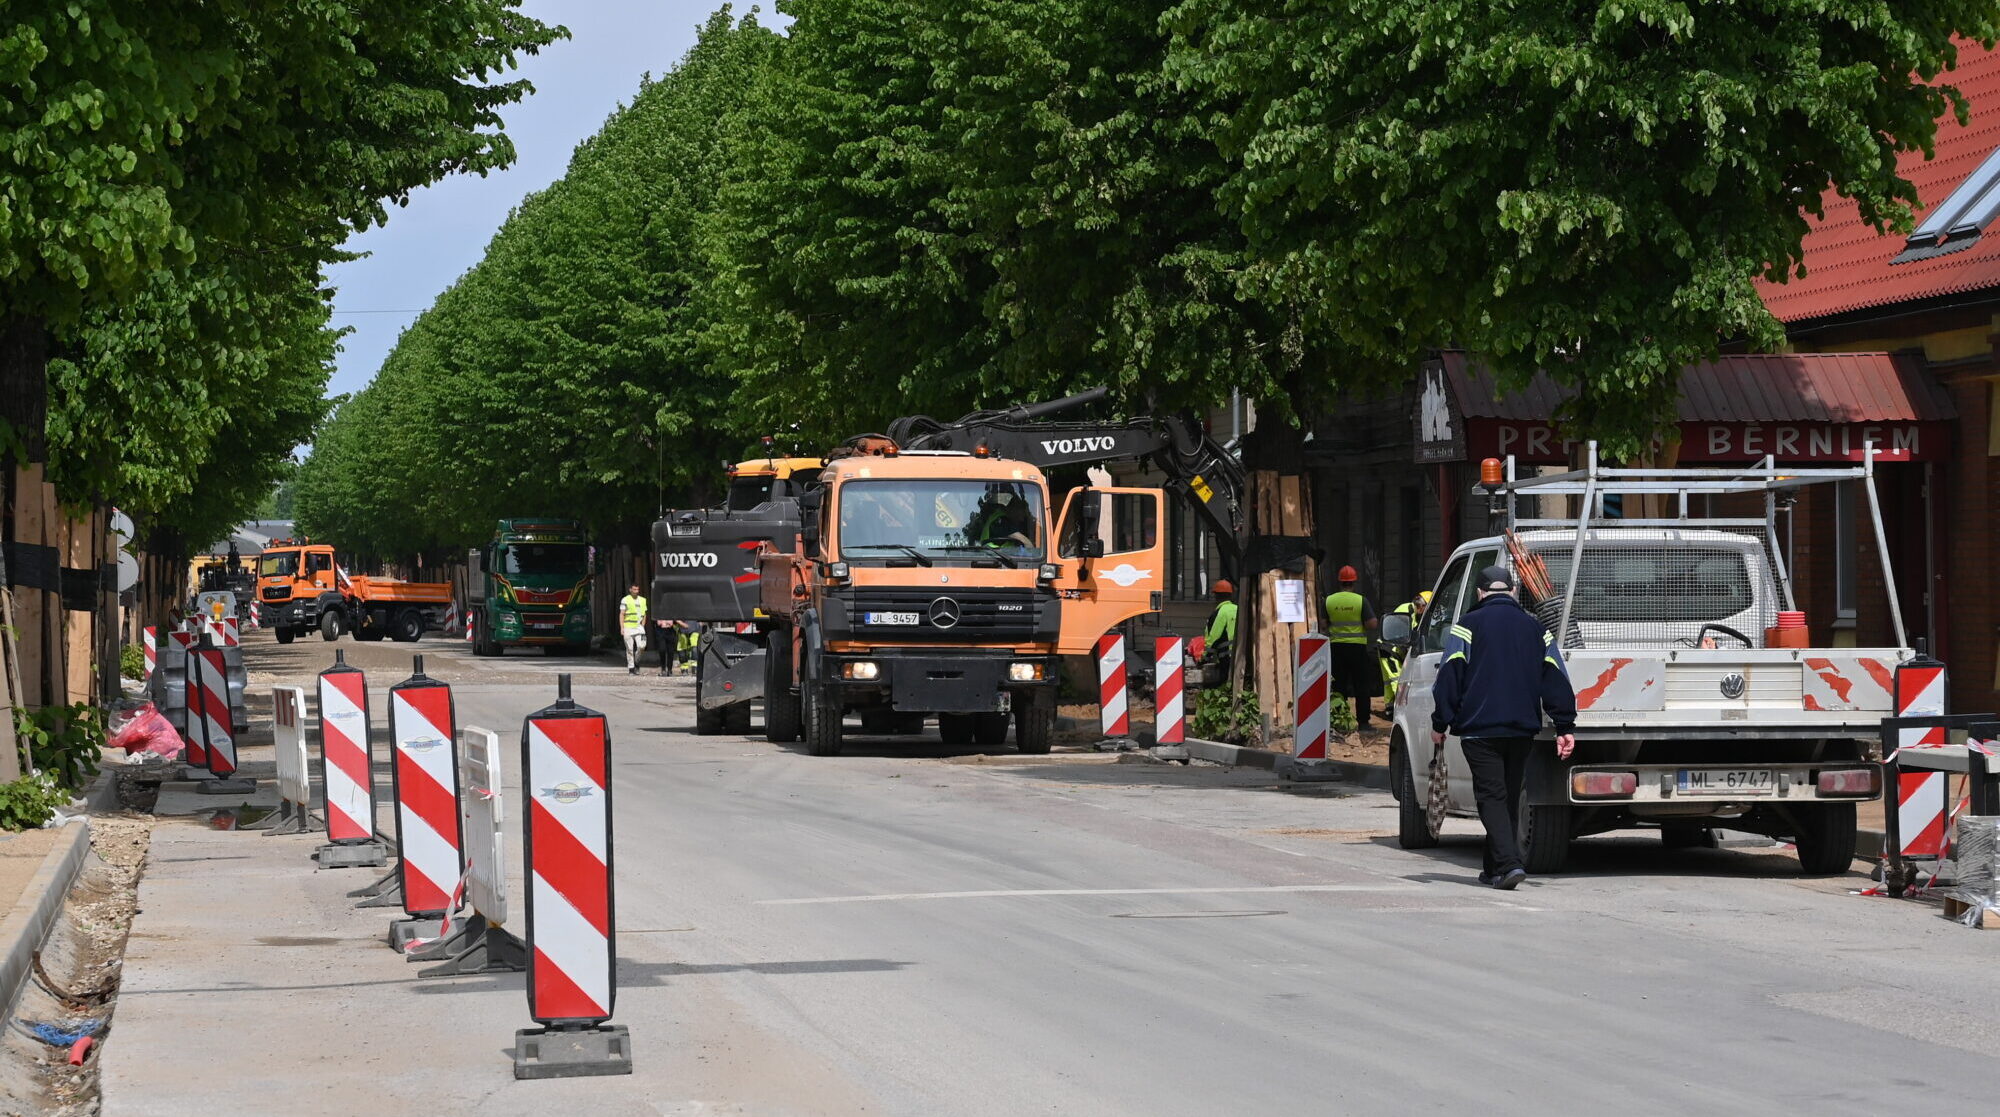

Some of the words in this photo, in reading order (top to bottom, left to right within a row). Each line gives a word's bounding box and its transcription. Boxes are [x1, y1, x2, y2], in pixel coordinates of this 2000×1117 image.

[1040, 436, 1116, 455] VOLVO
[660, 552, 718, 568] VOLVO
[872, 614, 918, 623] JL-9457
[1691, 772, 1769, 788] ML-6747
